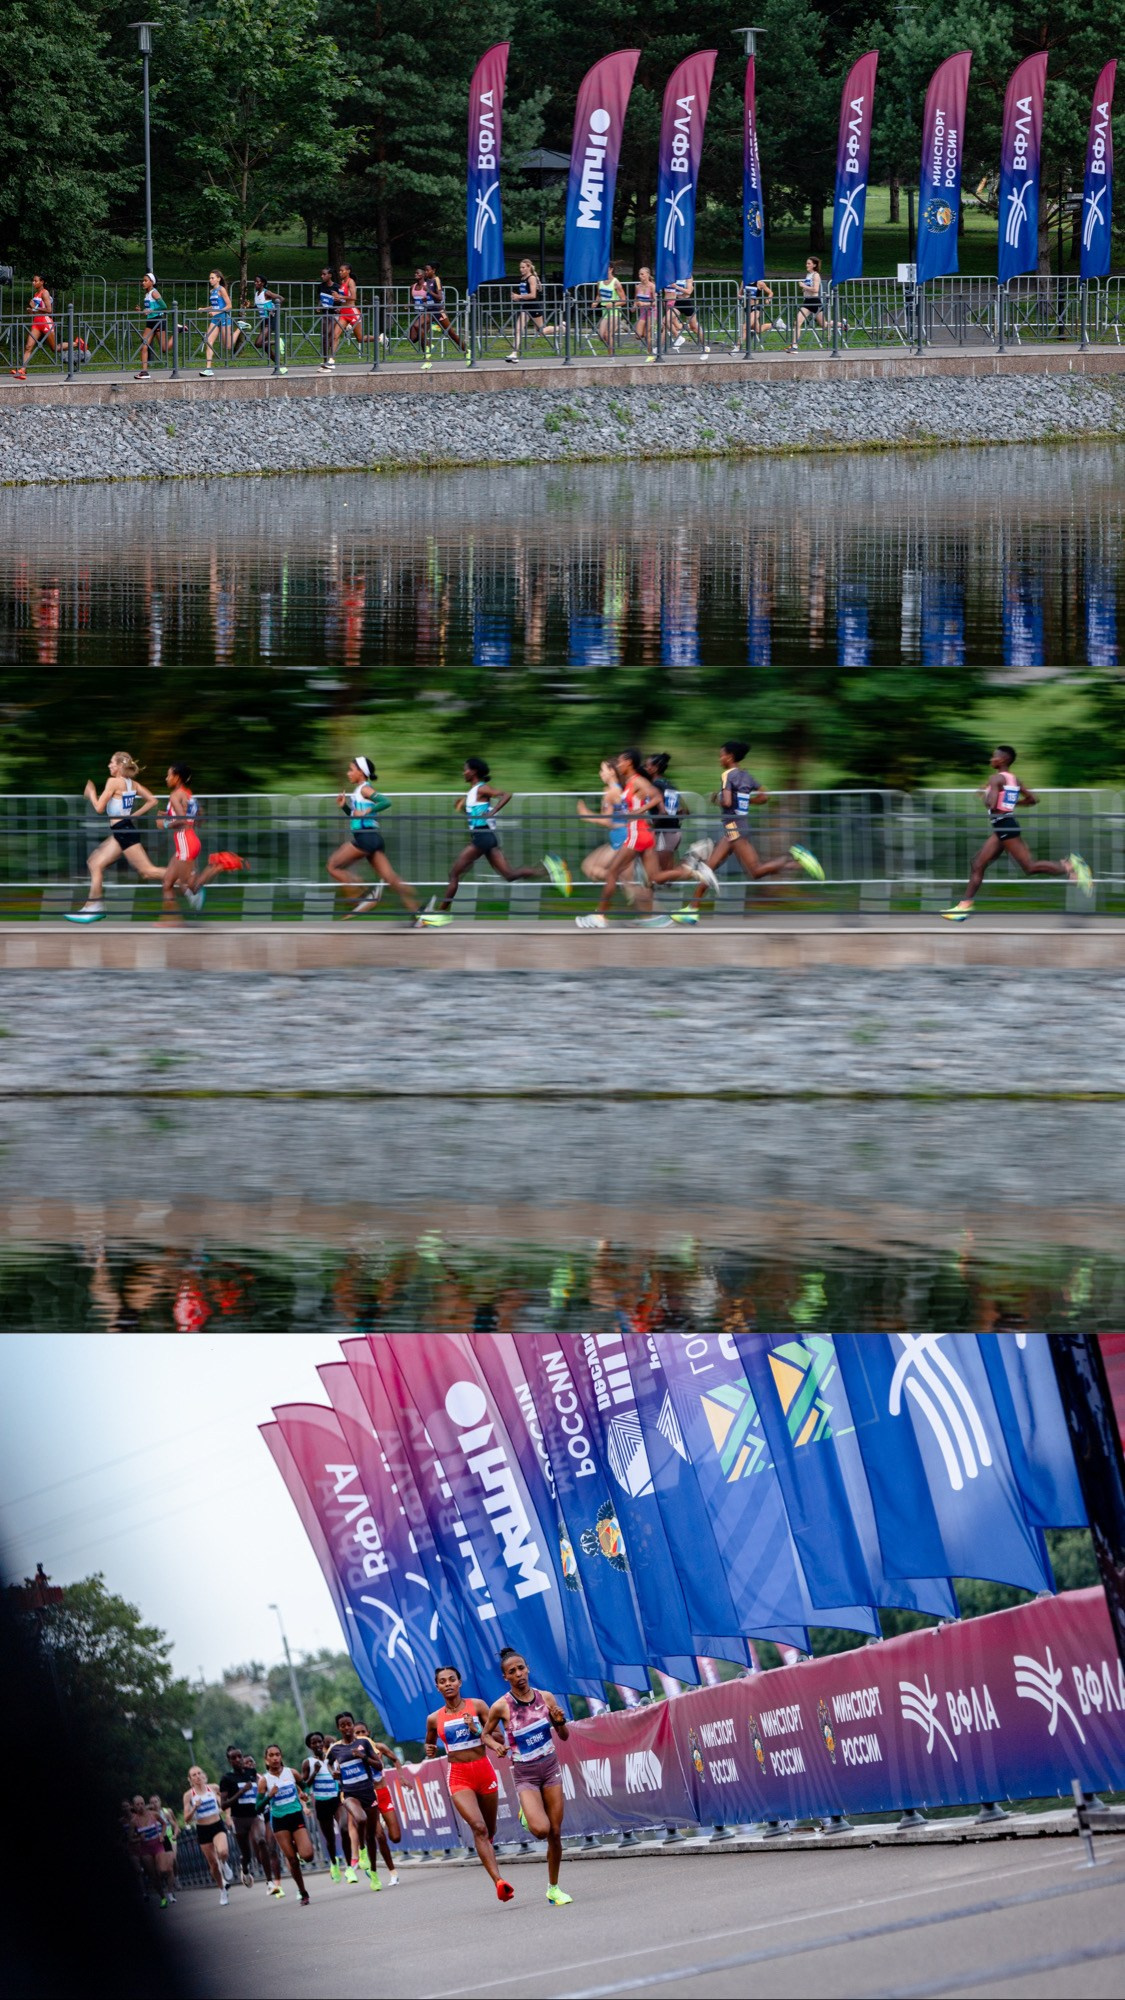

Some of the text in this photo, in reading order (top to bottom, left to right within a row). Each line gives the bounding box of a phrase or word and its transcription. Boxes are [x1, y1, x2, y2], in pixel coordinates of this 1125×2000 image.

[477, 89, 496, 170] ВФЛА
[670, 94, 696, 173] ВФЛА
[845, 96, 865, 174] ВФЛА
[932, 108, 946, 187] МИНСПОРТ
[1012, 95, 1033, 171] ВФЛА
[1090, 101, 1109, 175] ВФЛА
[945, 129, 957, 188] РОССИИ
[759, 1704, 804, 1738] МИНСПОРТ
[832, 1686, 883, 1723] МИНСПОРТ
[945, 1684, 1001, 1736] ВФЛА
[699, 1718, 738, 1749] МИНСПОРТ
[841, 1733, 883, 1767] РОССИИ
[708, 1758, 740, 1785] РОССИИ
[769, 1747, 806, 1777] РОССИИ
